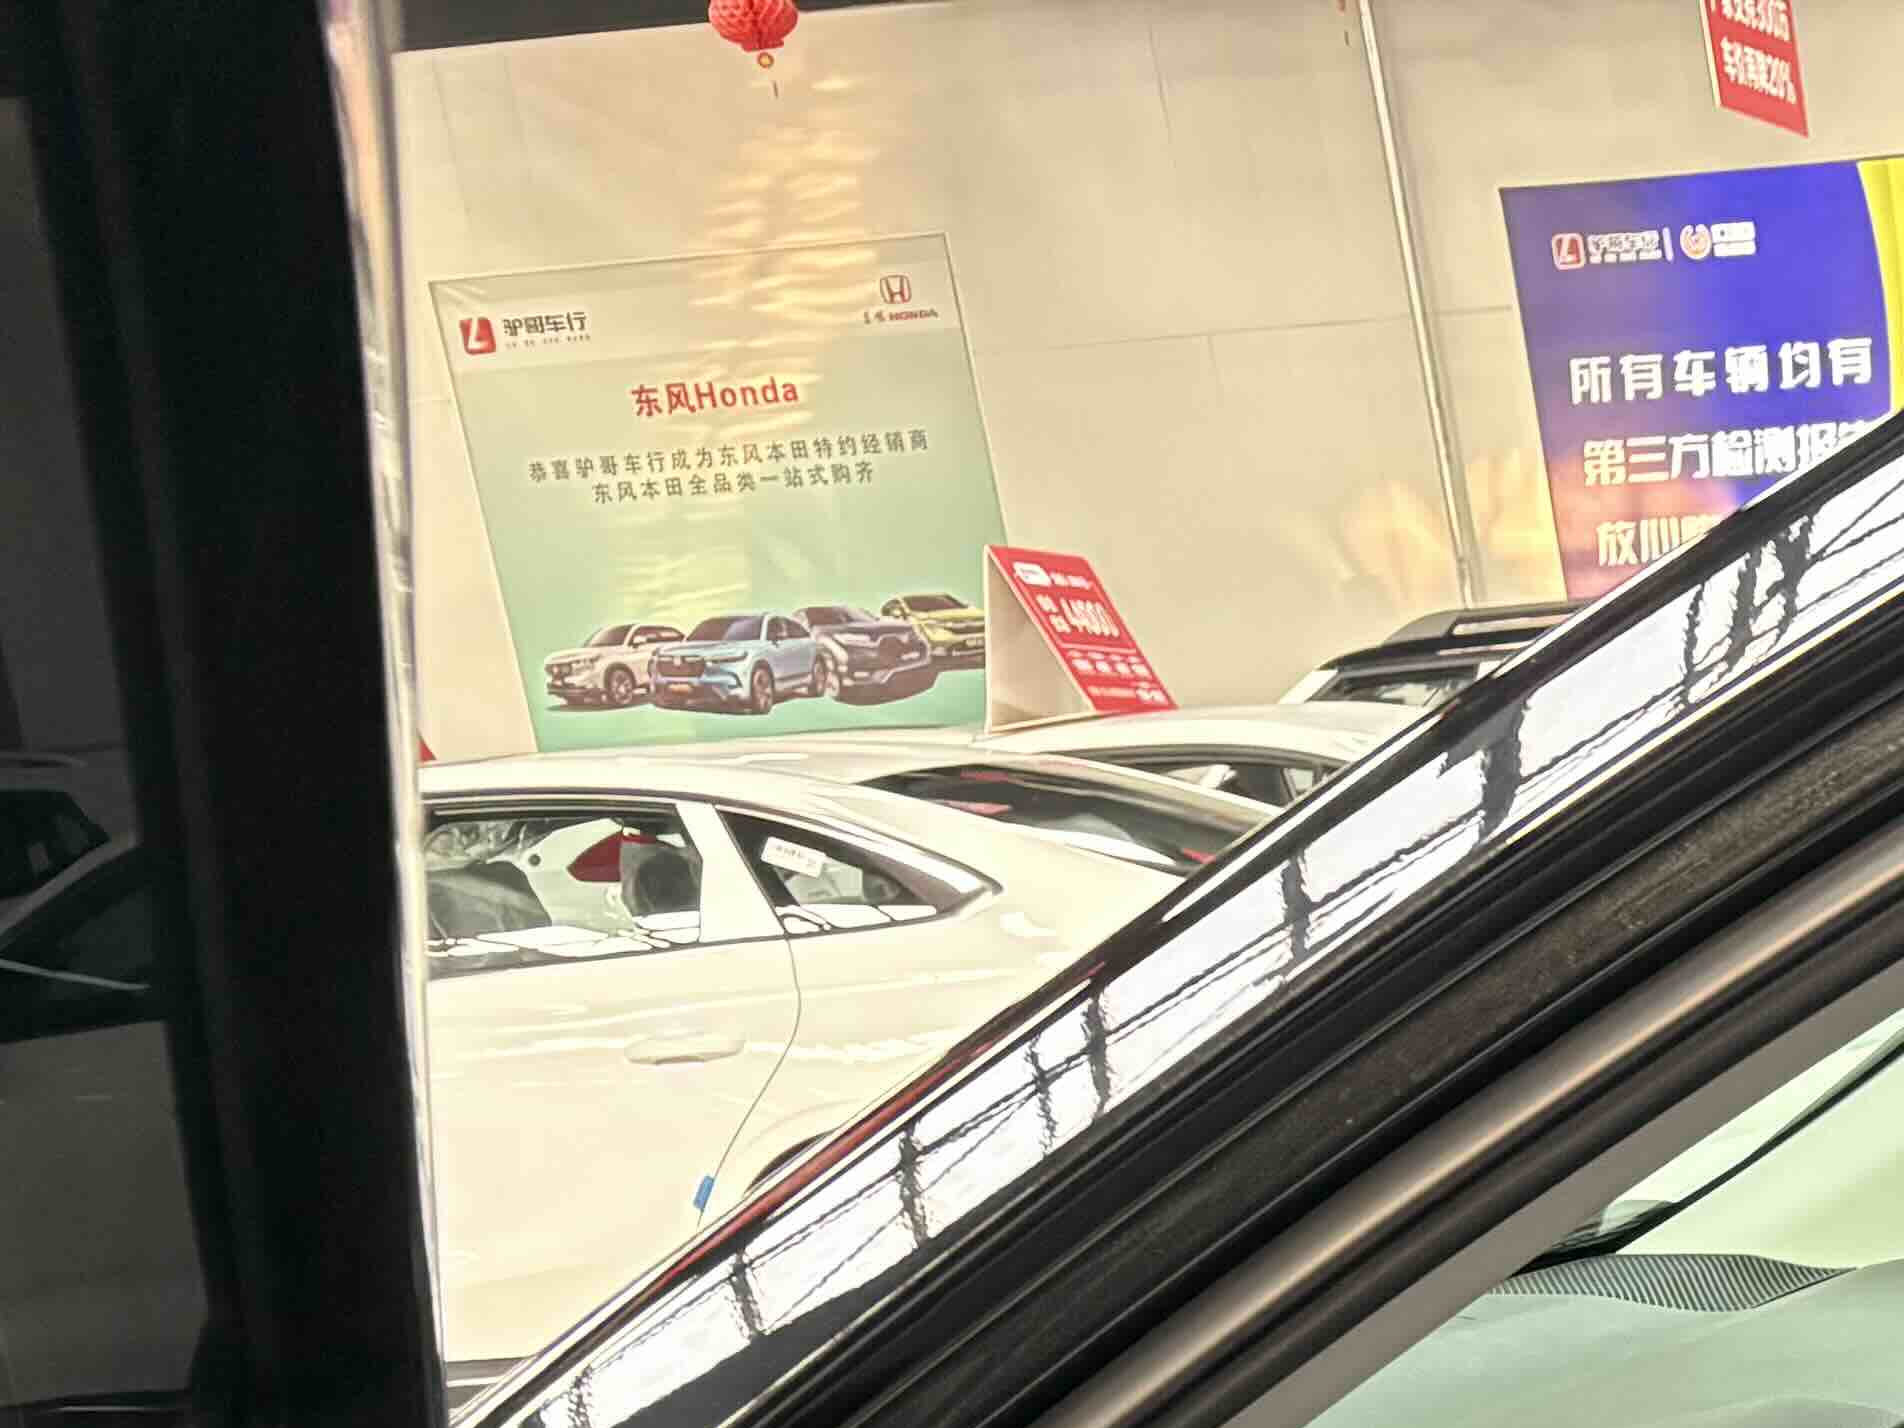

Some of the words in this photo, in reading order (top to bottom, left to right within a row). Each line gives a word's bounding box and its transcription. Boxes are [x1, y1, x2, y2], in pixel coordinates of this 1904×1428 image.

[503, 311, 588, 337] 驴哥车行
[1569, 337, 1872, 405] 所有车辆均有
[631, 377, 799, 418] 东风Honda
[528, 429, 930, 483] 恭喜驴哥车行成为东风本田特约经销商
[591, 460, 874, 505] 东风本田全品类一站式购齐
